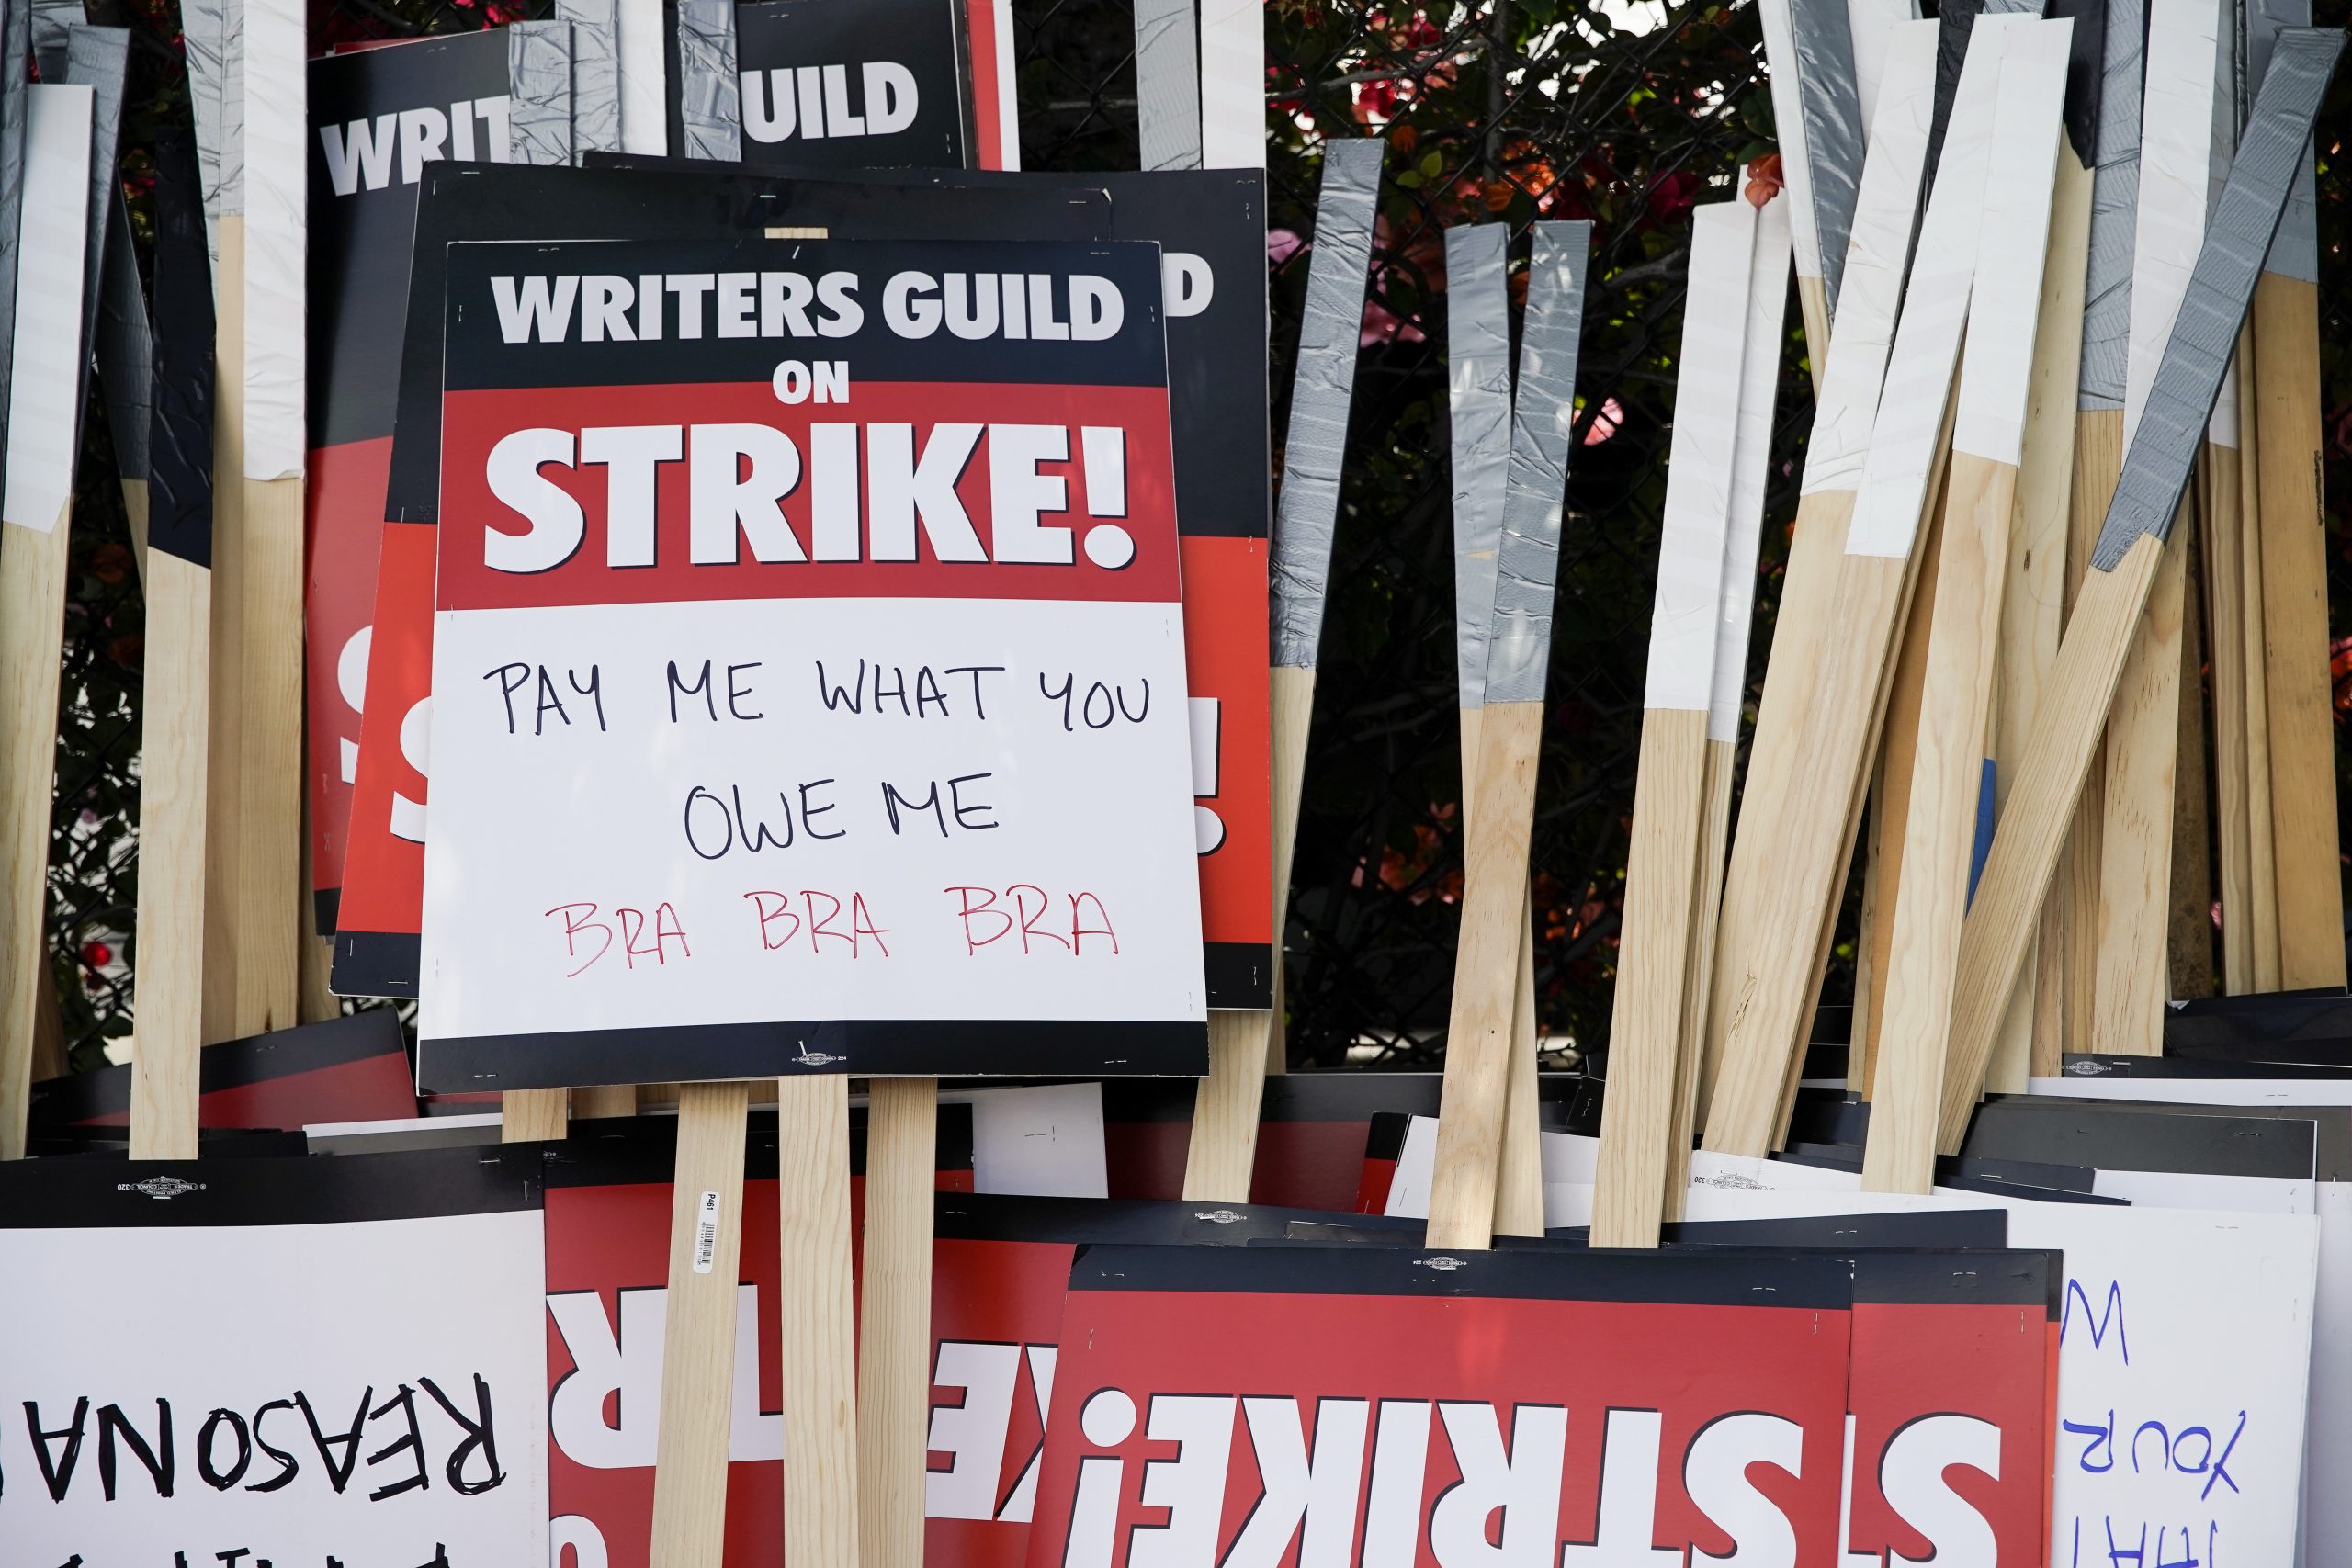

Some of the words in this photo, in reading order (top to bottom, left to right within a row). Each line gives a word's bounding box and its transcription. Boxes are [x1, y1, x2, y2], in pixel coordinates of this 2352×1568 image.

[319, 95, 511, 197] WRIT
[740, 61, 919, 143] UILD
[490, 271, 865, 344] WRITERS
[882, 271, 1125, 341] GUILD
[772, 359, 850, 404] ON
[484, 422, 1137, 574] STRIKE!
[483, 661, 606, 736] PAY
[667, 659, 764, 723] ME
[816, 658, 1005, 720] WHAT
[1039, 671, 1149, 732] YOU
[684, 778, 846, 860] OWE
[881, 773, 1000, 838] ME
[545, 902, 691, 977] BRA
[743, 889, 890, 959] BRA
[944, 884, 1118, 956] BRA
[117, 1183, 130, 1191] 320
[706, 1193, 717, 1211] P461
[1694, 1176, 1706, 1184] 320
[0, 1373, 507, 1504] REASONA
[1060, 1388, 1804, 1568] STRIKE!
[2063, 1408, 2246, 1503] YOUR
